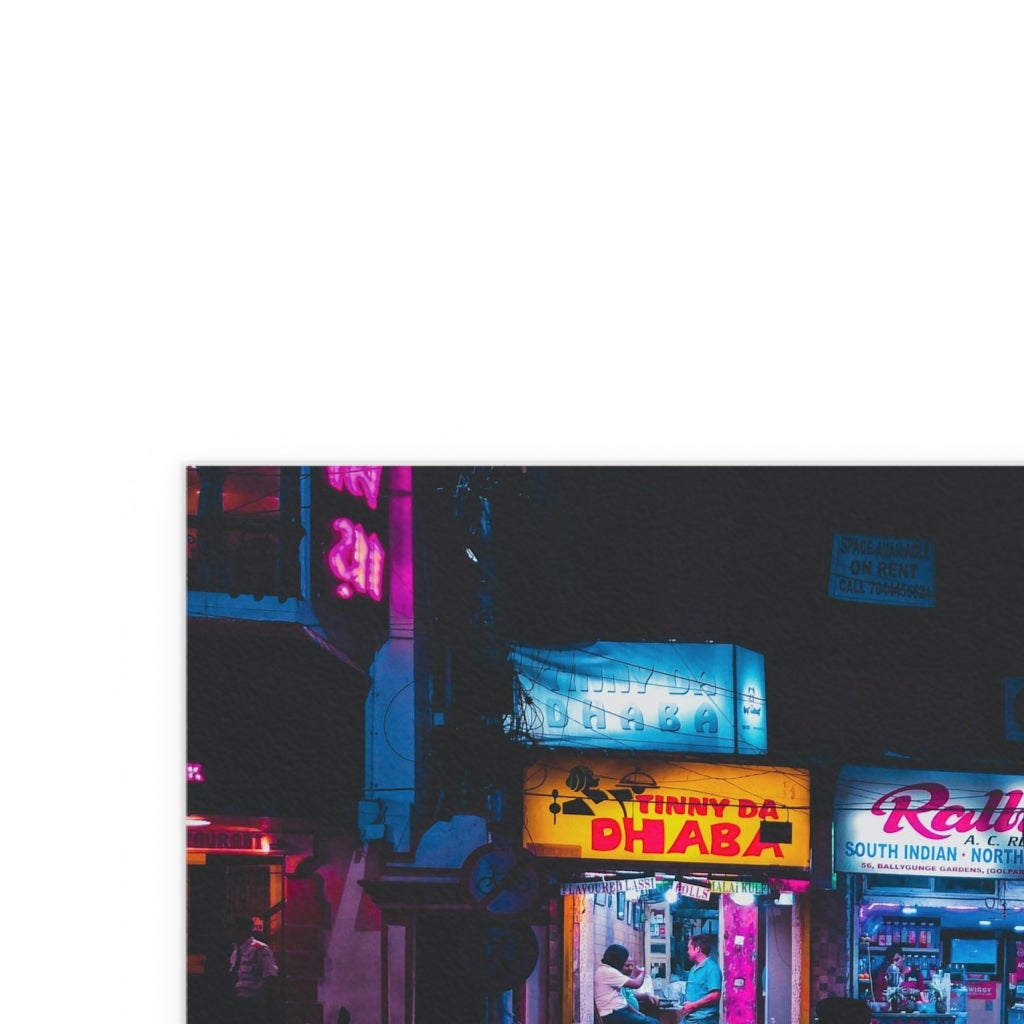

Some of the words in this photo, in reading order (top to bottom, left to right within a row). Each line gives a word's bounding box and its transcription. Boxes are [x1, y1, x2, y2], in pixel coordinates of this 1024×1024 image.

[850, 560, 872, 576] ON
[878, 561, 917, 579] RENT
[839, 580, 865, 594] CALL
[547, 700, 719, 734] DHABA
[634, 794, 731, 818] TINNY
[738, 798, 780, 820] DA
[591, 817, 785, 858] DHABA
[964, 835, 979, 846] A.
[987, 836, 1000, 847] C.
[845, 841, 898, 860] SOUTH
[904, 843, 957, 862] INDIAN
[877, 864, 937, 872] BALLYGUNGE
[939, 865, 984, 874] GARDENS,
[561, 880, 622, 895] FLAVOURED
[625, 878, 655, 891] LASSI
[708, 880, 739, 893] MALAI
